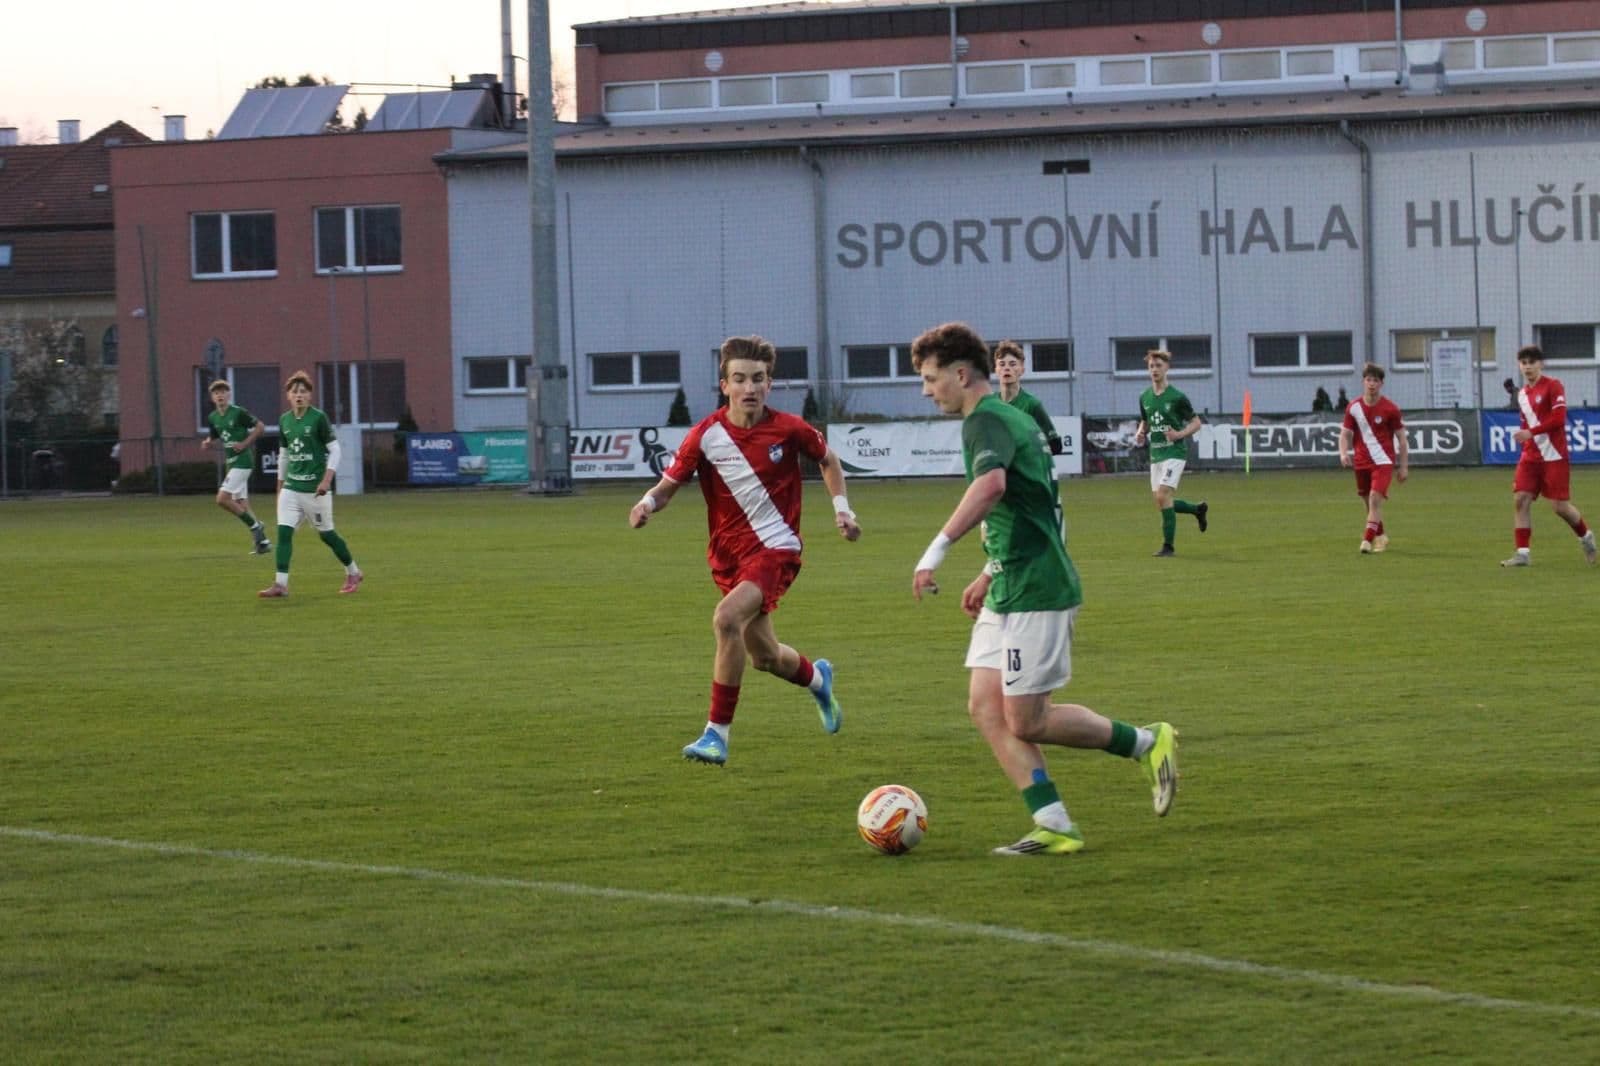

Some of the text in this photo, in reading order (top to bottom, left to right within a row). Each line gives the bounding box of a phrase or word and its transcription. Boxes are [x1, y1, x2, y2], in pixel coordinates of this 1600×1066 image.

[837, 200, 1161, 269] SPORTOVNÍ
[1200, 204, 1360, 255] HALA
[857, 438, 872, 448] OK
[857, 448, 892, 457] KLIENT
[1007, 648, 1022, 672] 13
